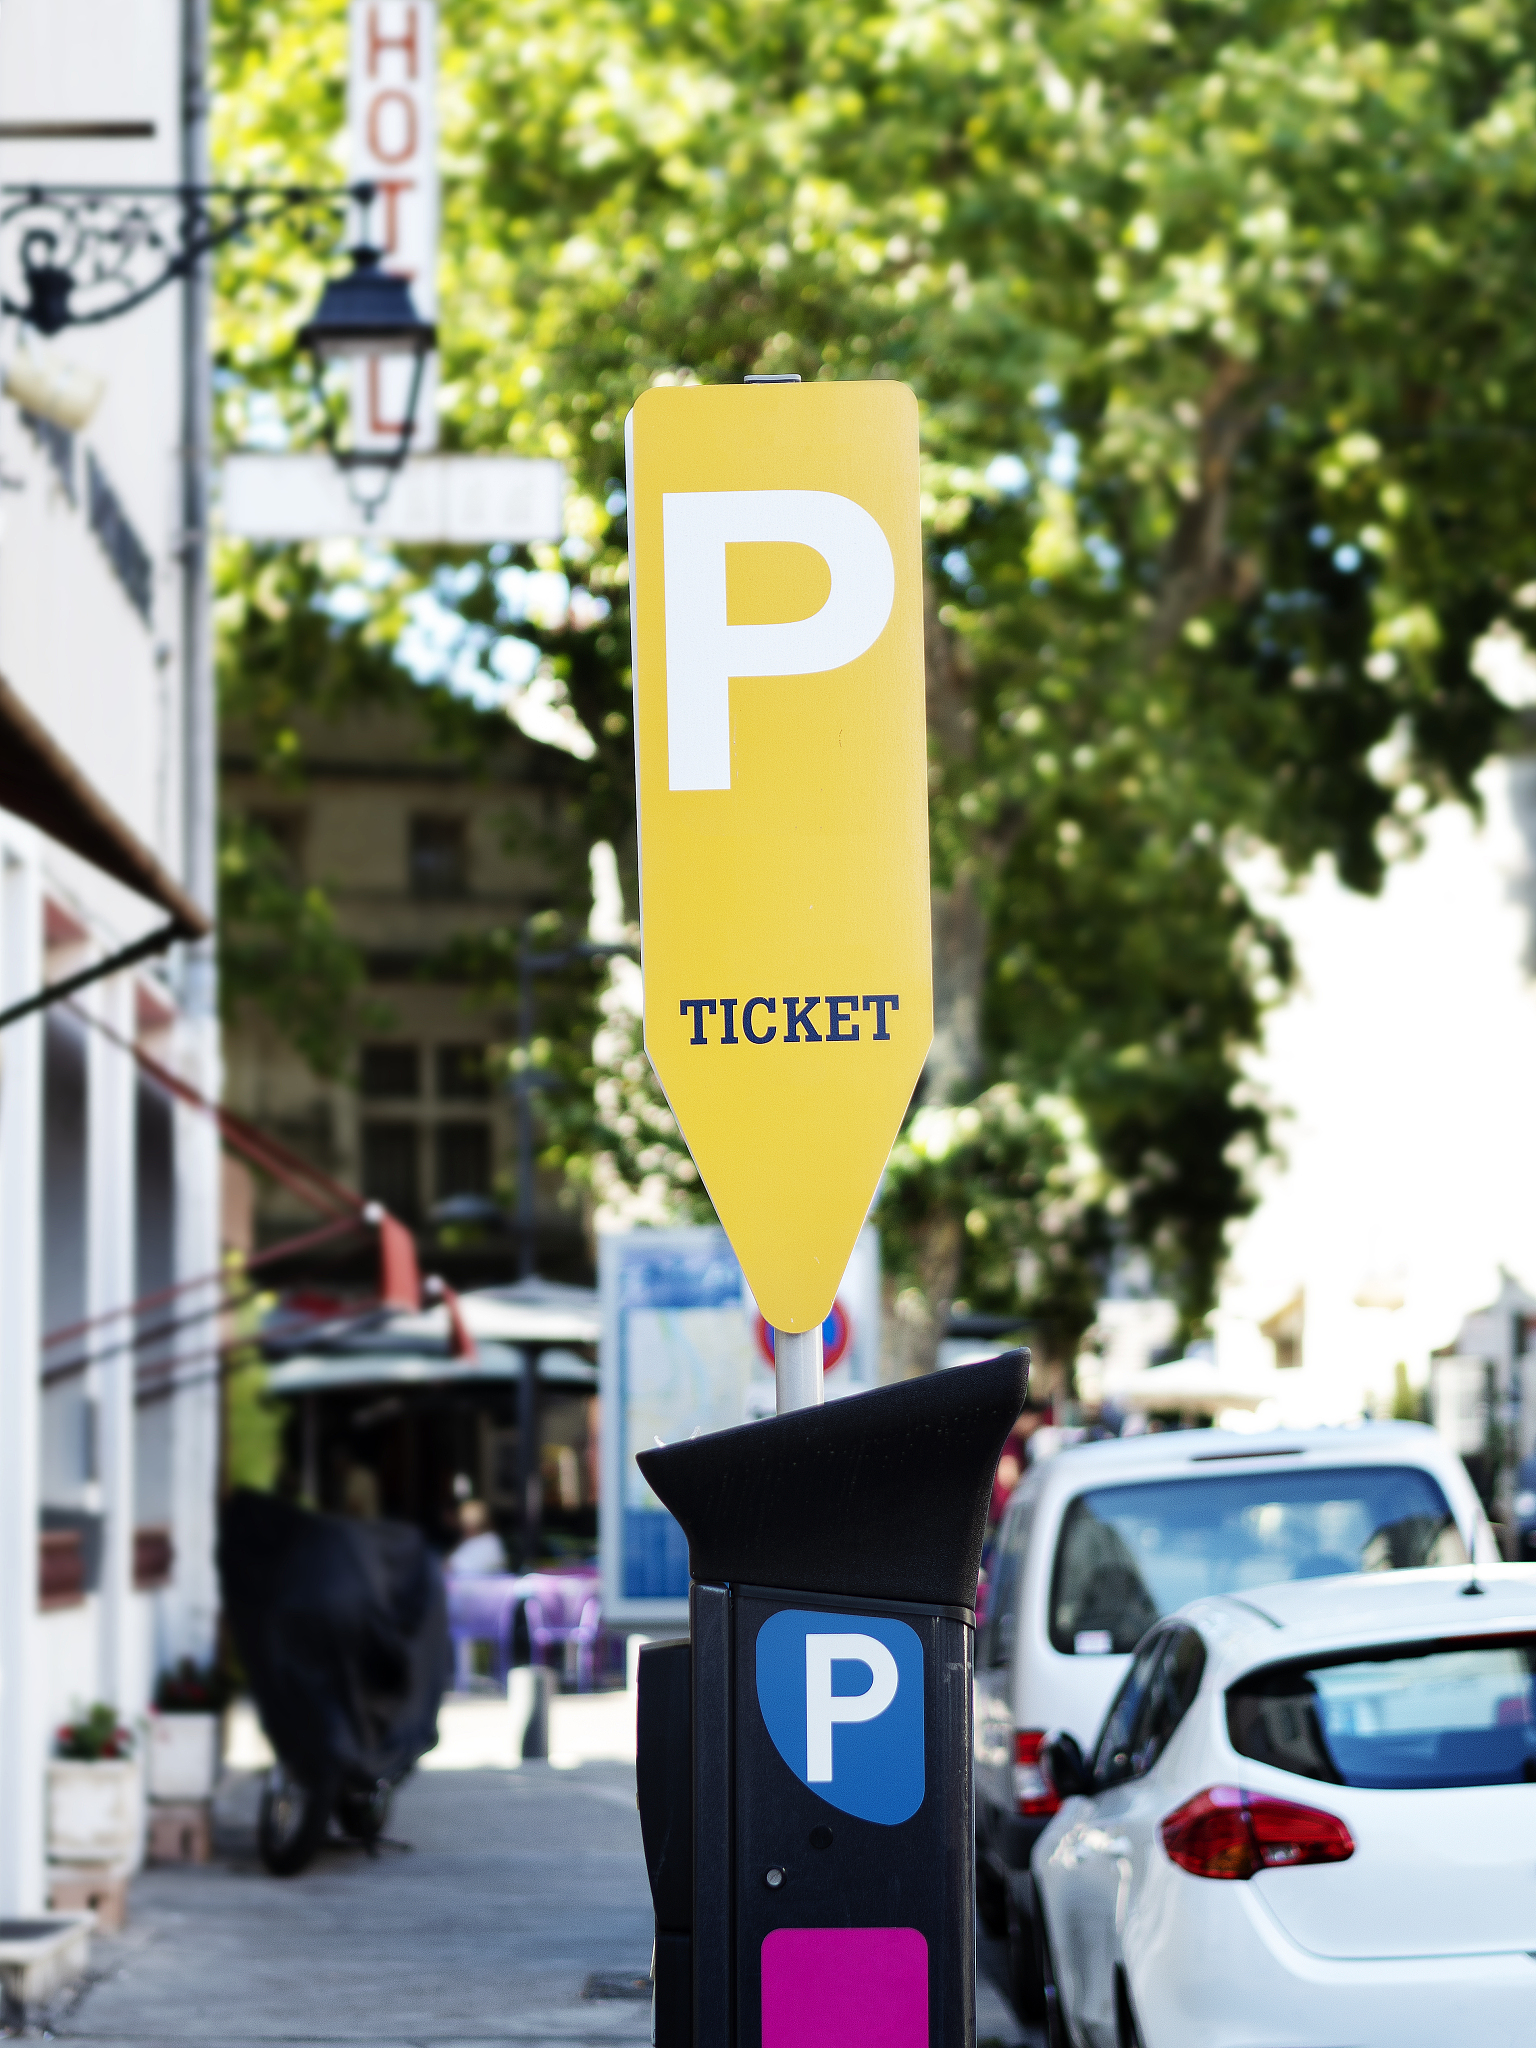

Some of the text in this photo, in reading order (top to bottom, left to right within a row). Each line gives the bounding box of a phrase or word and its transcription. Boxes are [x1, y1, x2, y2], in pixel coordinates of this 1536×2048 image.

[367, 3, 418, 435] HOTL
[663, 491, 895, 791] P
[680, 995, 900, 1045] TICKET
[805, 1633, 899, 1782] P
